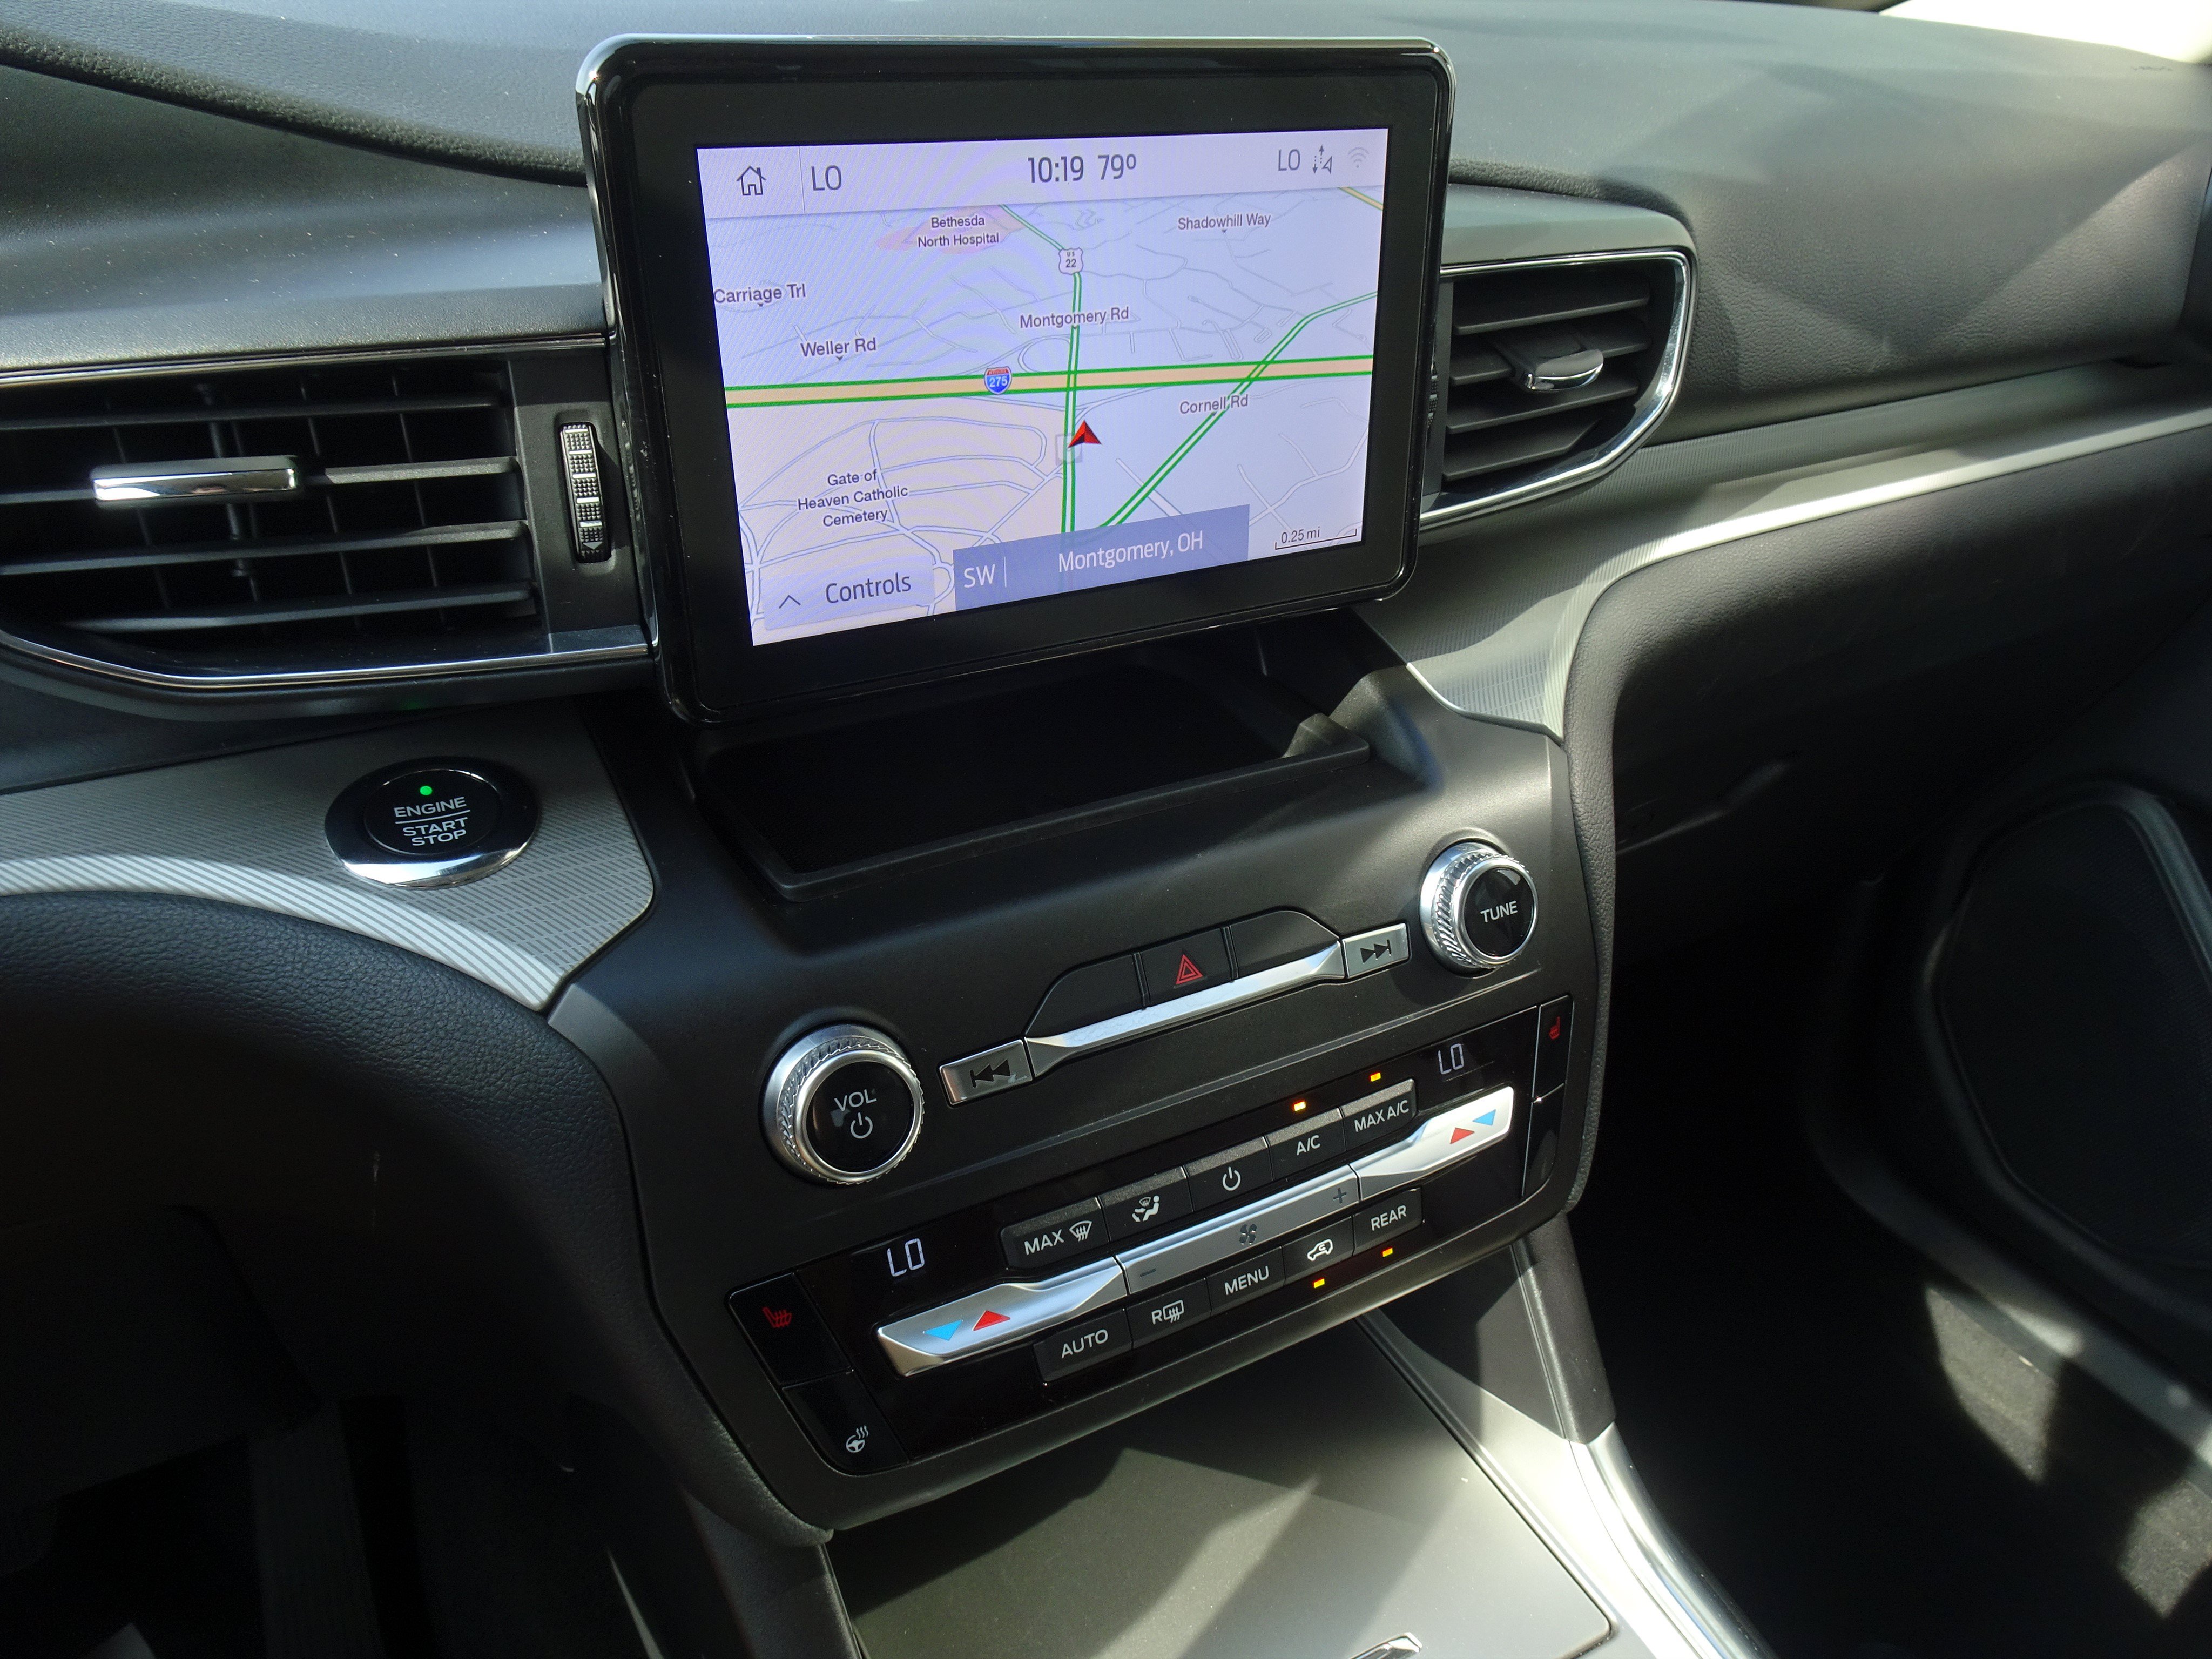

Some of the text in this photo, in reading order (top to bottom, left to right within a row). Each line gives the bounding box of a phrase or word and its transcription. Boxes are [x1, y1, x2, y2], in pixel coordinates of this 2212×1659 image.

[1028, 156, 1084, 183] 10:19
[1277, 149, 1300, 171] LO
[811, 164, 842, 191] LO
[930, 215, 985, 228] Bethesda
[1178, 213, 1271, 231] Shadowhill Way
[918, 233, 1000, 248] North Hospital
[1065, 259, 1076, 268] 22
[714, 284, 805, 304] Carriage Trl
[1020, 307, 1129, 328] Montgomery Rd
[800, 338, 876, 357] Weller Rd
[989, 376, 1008, 387] 275
[1179, 394, 1248, 414] Cornell Rd
[827, 468, 877, 485] Gate of
[798, 487, 908, 510] Heaven Catholic
[823, 510, 887, 527] Cemetery
[1281, 527, 1320, 544] 0.25 mi
[1058, 530, 1203, 572] Montgomery, OH
[964, 563, 995, 588] SW
[825, 572, 911, 604] Controls
[394, 797, 467, 818] ENGINE
[403, 817, 468, 837] START
[412, 829, 467, 846] STOP
[1480, 901, 1518, 922] TUNE
[1438, 1043, 1465, 1075] LO
[834, 1089, 877, 1111] VOL
[1354, 1100, 1410, 1132] MAX A/C
[1296, 1135, 1321, 1155] A/C
[1370, 1205, 1407, 1231] REAR
[1024, 1229, 1064, 1255] MAX
[886, 1238, 925, 1277] LO
[1224, 1266, 1270, 1296] MENU
[1061, 1329, 1108, 1358] AUTO
